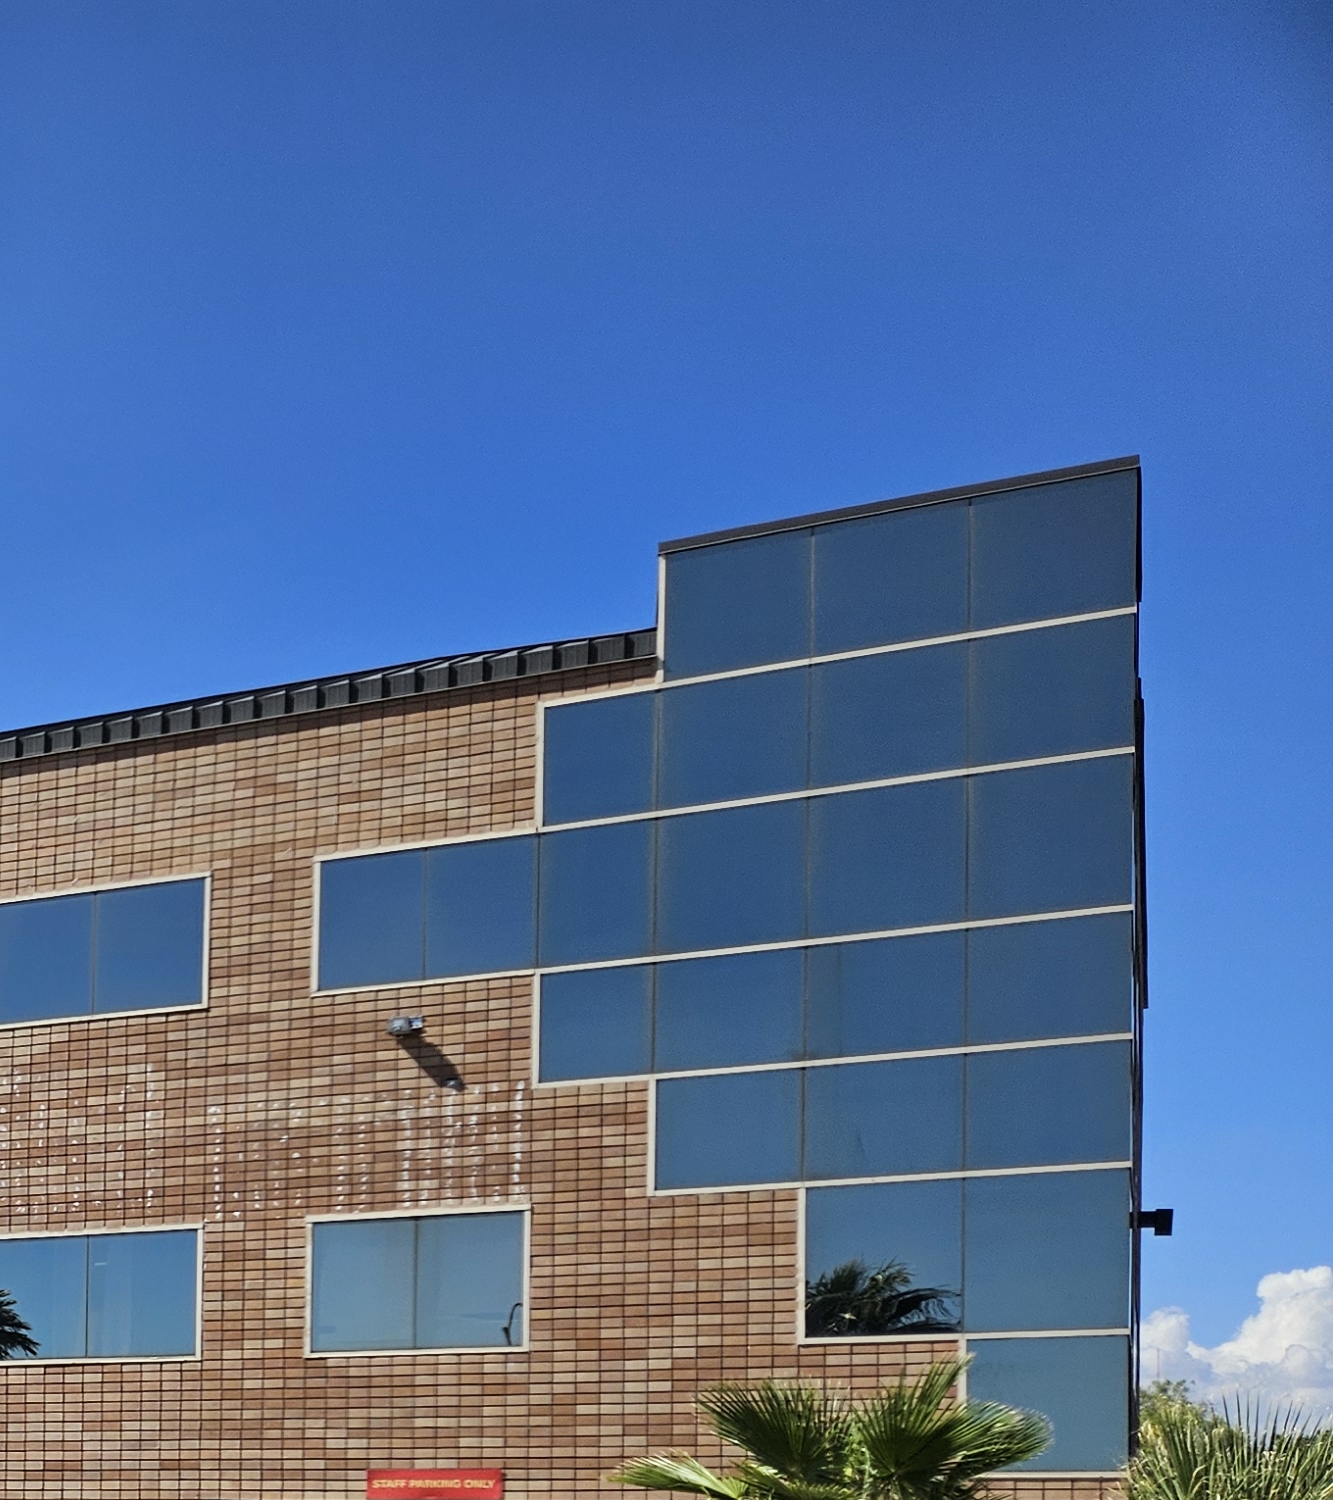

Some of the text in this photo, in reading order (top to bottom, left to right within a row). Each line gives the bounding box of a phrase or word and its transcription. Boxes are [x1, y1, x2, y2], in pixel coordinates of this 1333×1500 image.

[372, 1479, 495, 1489] STAFF PARKING ONLY
